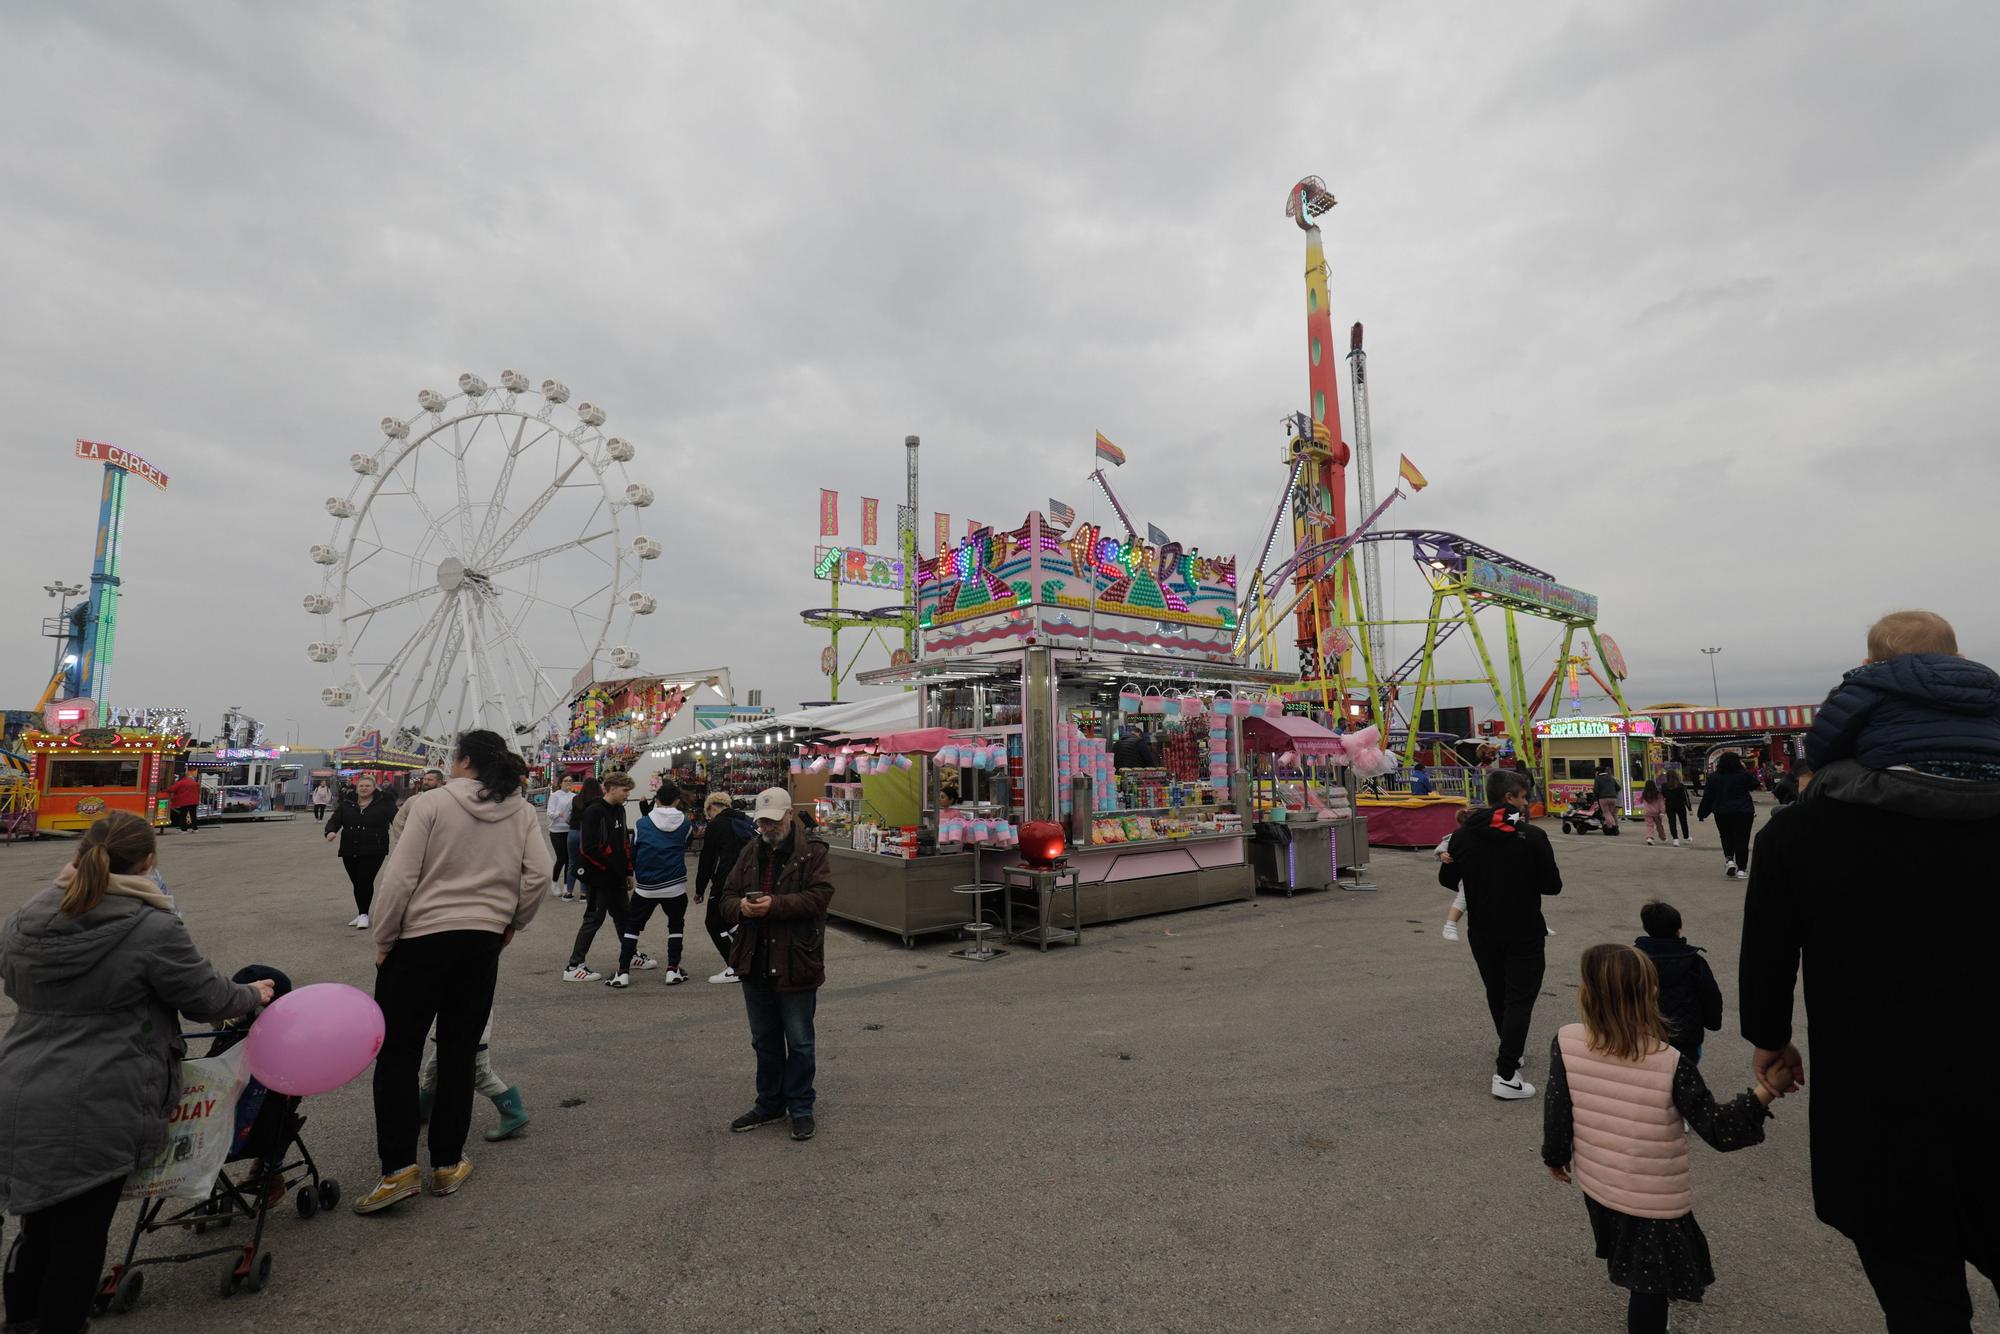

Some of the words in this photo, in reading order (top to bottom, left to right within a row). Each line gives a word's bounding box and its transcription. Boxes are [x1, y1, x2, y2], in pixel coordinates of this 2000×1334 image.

[79, 441, 99, 458] LA
[108, 446, 168, 489] CARCEL
[816, 548, 842, 578] SUPER
[847, 551, 905, 589] RAT
[1550, 722, 1578, 735] SUPER
[182, 1085, 205, 1095] ZAR
[168, 1100, 216, 1123] OLAY
